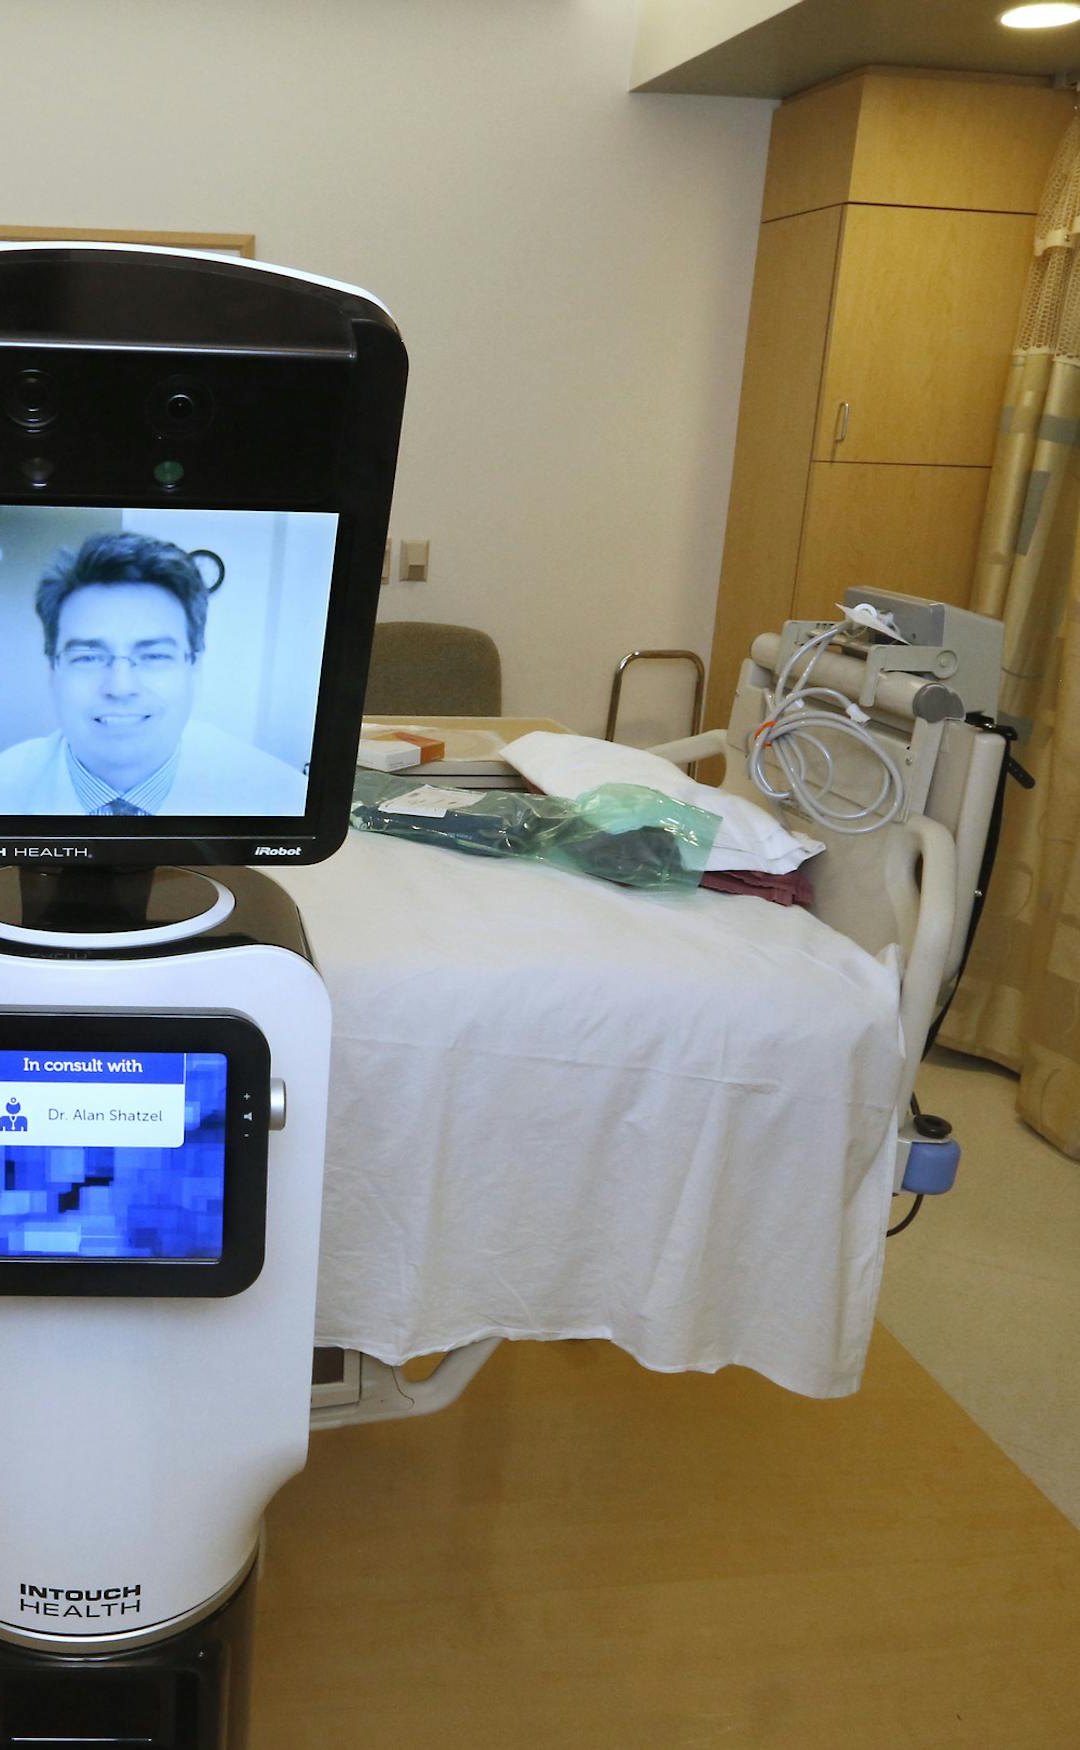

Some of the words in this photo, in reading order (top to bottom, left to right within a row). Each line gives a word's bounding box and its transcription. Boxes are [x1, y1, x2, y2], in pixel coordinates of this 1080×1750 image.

[14, 847, 88, 857] HEALTH
[254, 846, 302, 856] iRobot
[23, 1057, 40, 1072] In
[44, 1058, 103, 1073] consult
[107, 1059, 143, 1073] with
[48, 1108, 68, 1121] Dr.
[73, 1108, 104, 1121] Alan
[109, 1108, 162, 1122] Shatzel
[20, 1583, 141, 1601] INTOUCH
[20, 1599, 140, 1618] HEALTH
